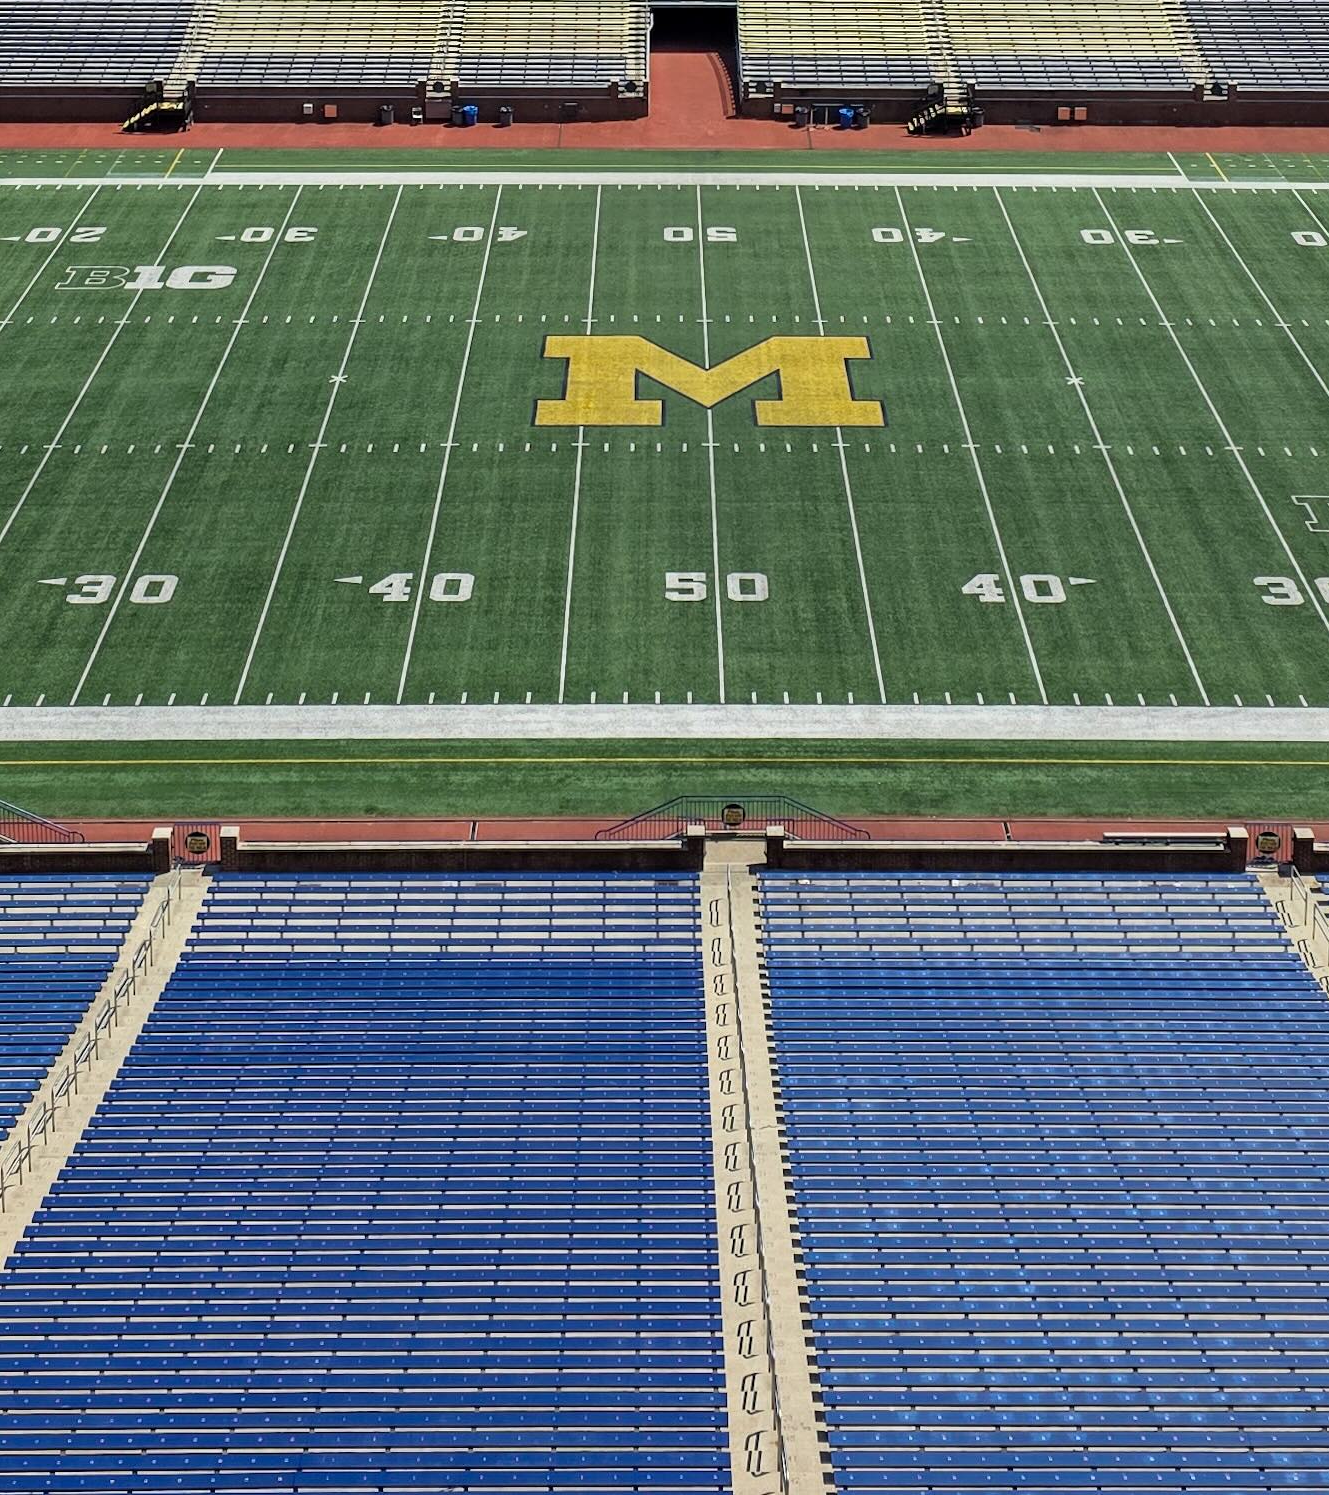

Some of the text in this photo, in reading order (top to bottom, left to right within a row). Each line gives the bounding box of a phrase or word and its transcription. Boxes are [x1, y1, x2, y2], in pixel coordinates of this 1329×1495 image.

[24, 226, 108, 243] 20
[241, 226, 320, 243] 30
[452, 225, 529, 242] 40
[662, 226, 739, 242] 50
[871, 227, 947, 244] 40
[1079, 228, 1160, 245] 30
[531, 334, 889, 428] M
[65, 574, 179, 604] 30
[368, 572, 475, 602] 40
[664, 571, 769, 602] 50
[961, 573, 1067, 603] 40
